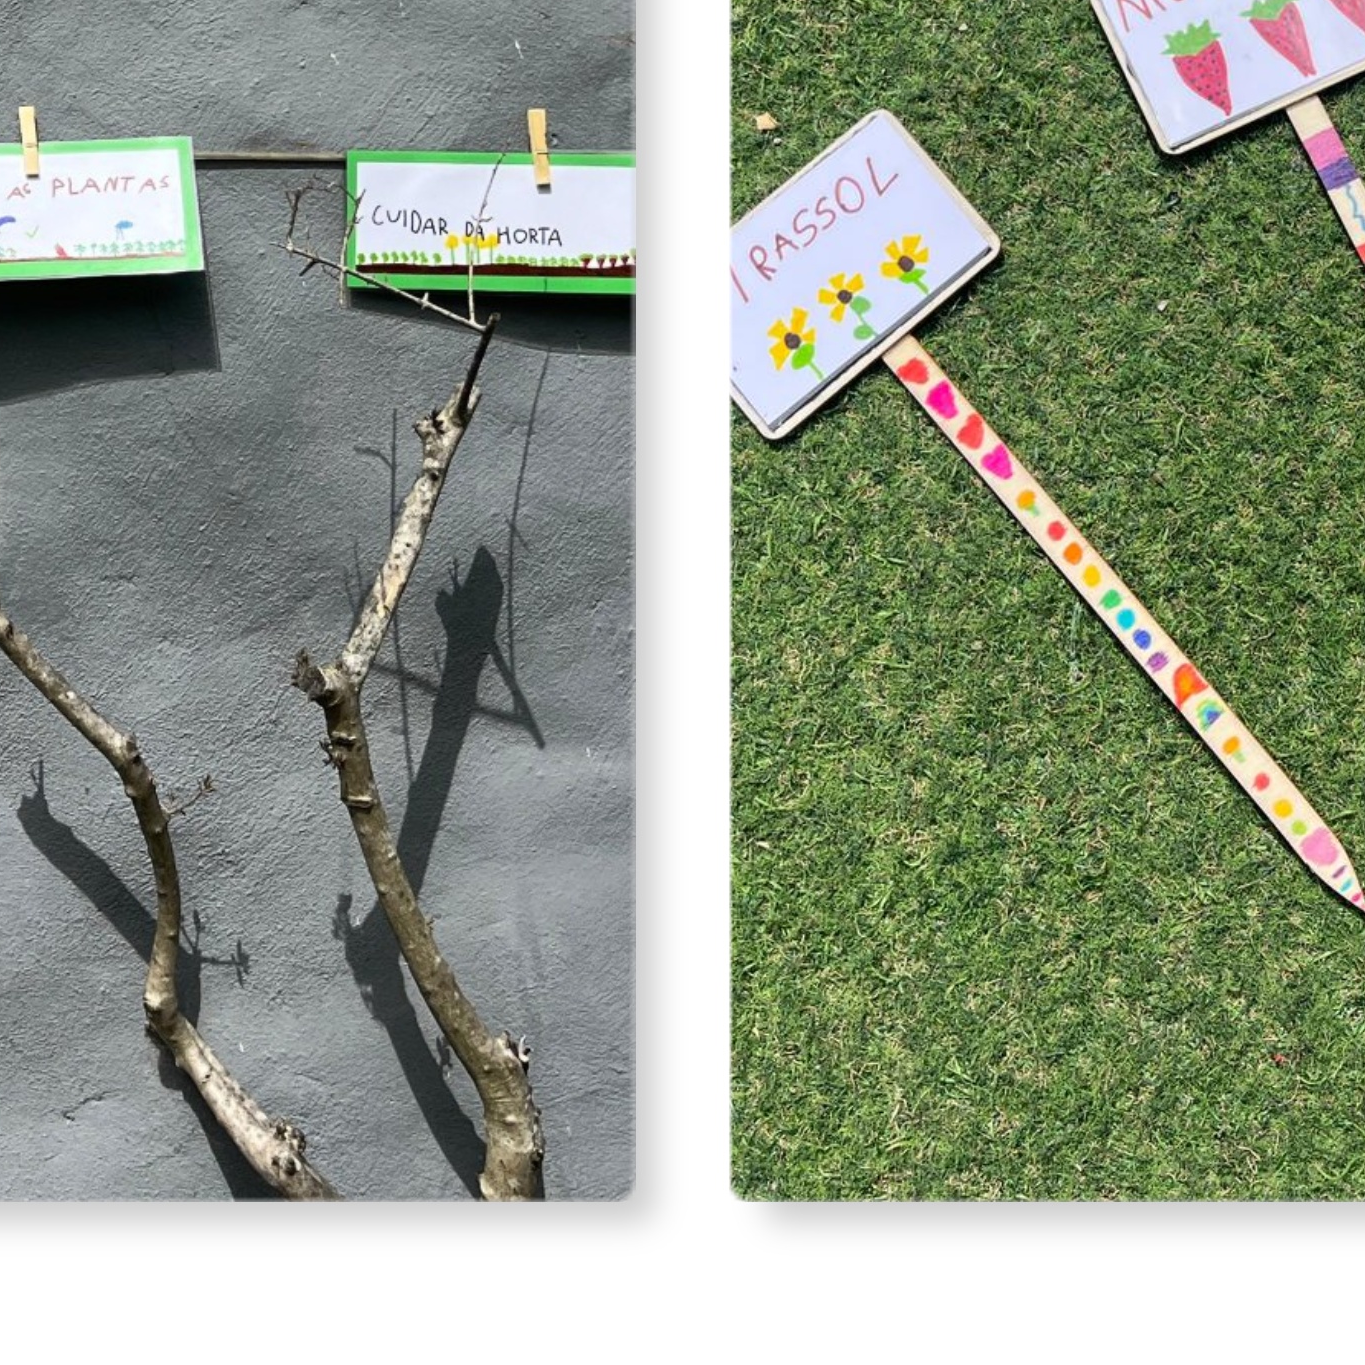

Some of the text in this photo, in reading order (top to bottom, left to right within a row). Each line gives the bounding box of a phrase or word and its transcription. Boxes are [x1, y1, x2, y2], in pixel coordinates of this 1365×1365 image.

[6, 183, 32, 201] AS
[51, 174, 170, 198] PLANTAS
[371, 204, 563, 248] CUIDAR DA HORTA
